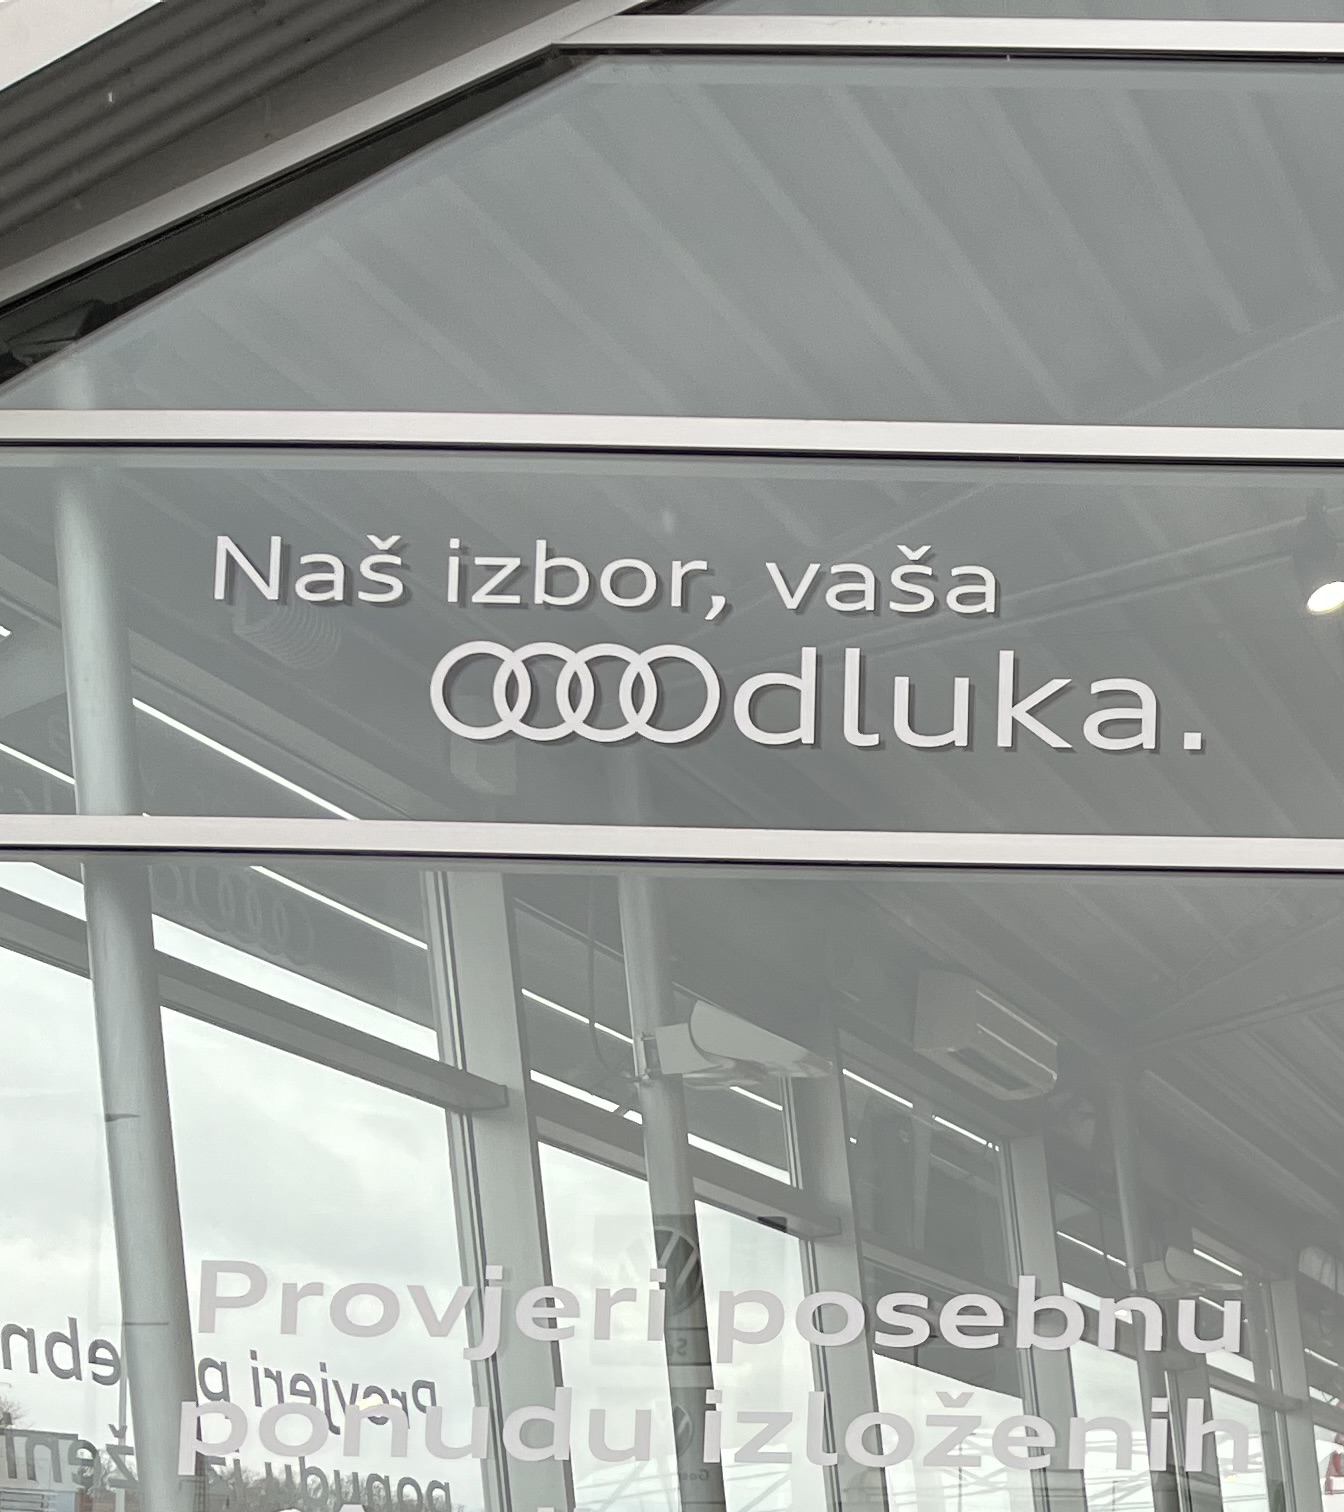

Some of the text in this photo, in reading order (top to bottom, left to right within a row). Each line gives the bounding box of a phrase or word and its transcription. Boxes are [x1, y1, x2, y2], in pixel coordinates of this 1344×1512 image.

[213, 534, 998, 621] Naš izbor, vaša
[198, 1259, 1243, 1364] Provjeri posebnu
[178, 1387, 1250, 1475] ponudu izloženih
